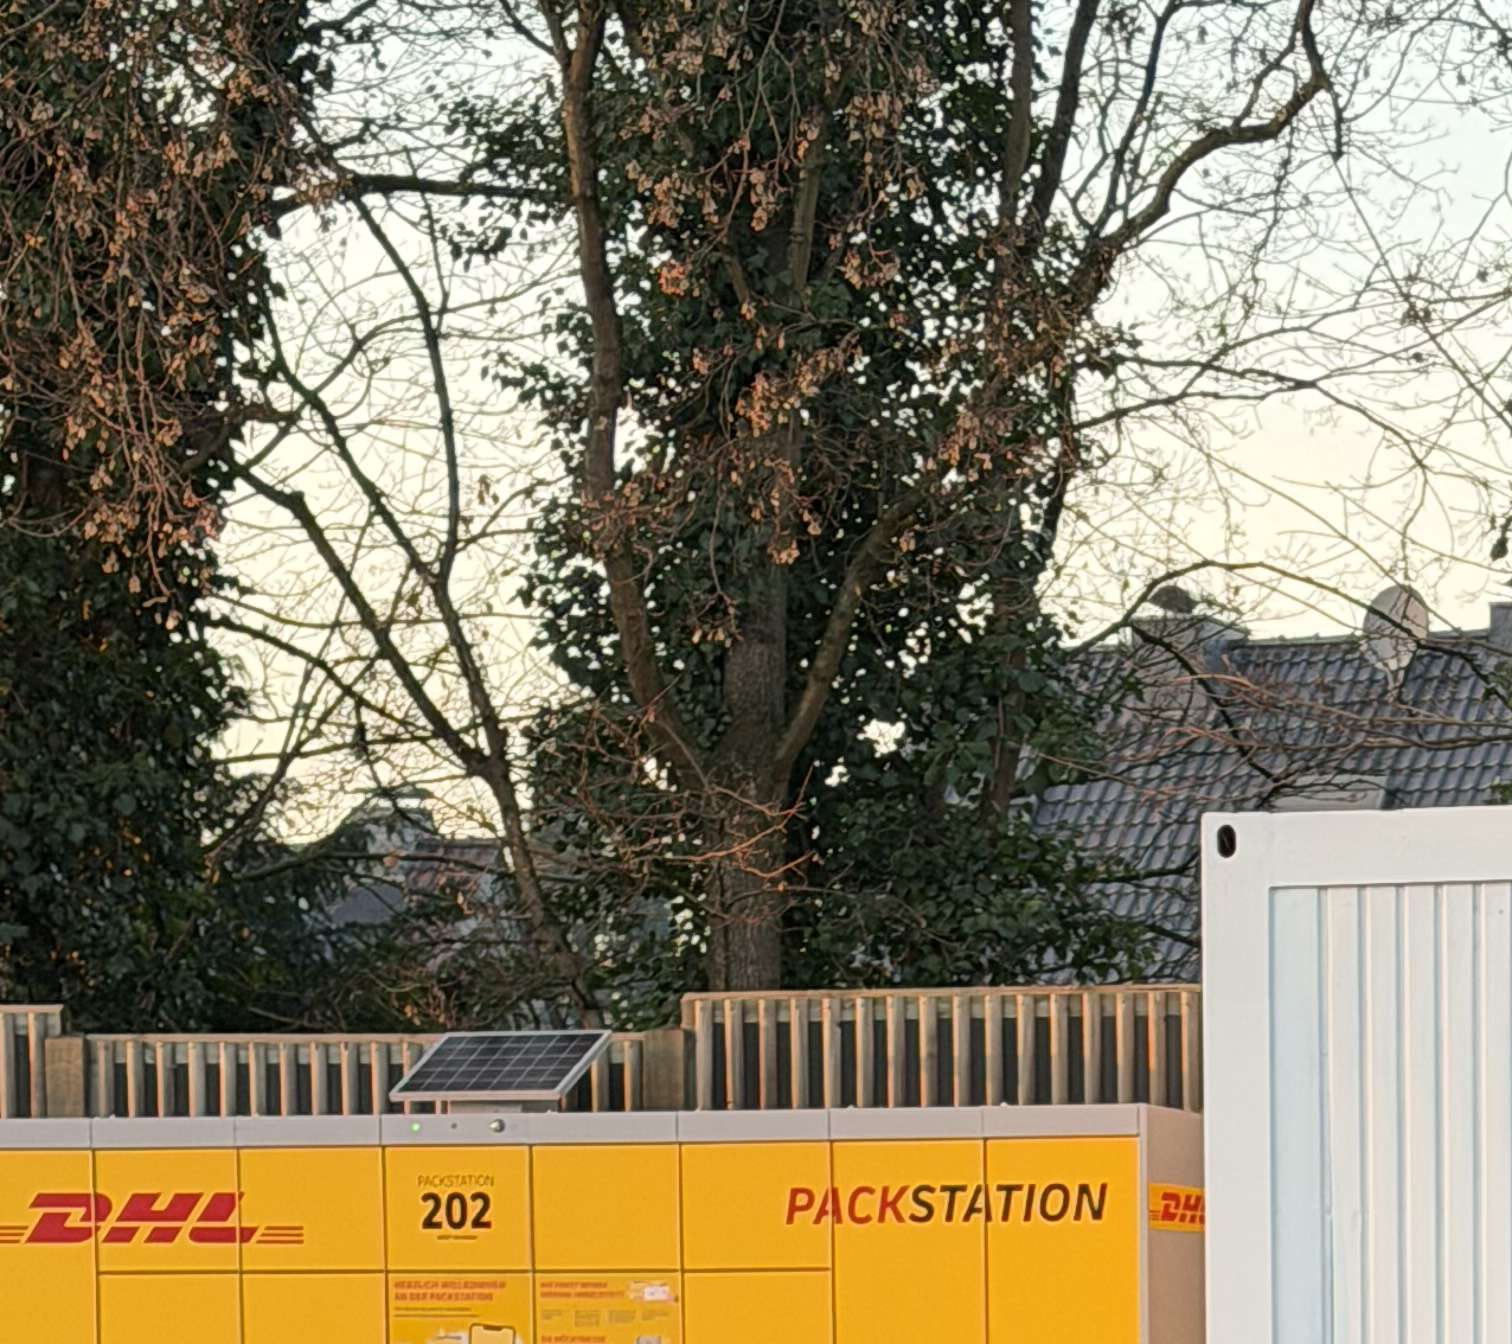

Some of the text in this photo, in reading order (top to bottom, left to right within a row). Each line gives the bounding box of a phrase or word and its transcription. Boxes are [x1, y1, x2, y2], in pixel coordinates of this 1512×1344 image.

[417, 1174, 495, 1187] PACKSTATION
[25, 1192, 259, 1244] DHL
[421, 1191, 492, 1230] 202
[785, 1182, 1107, 1226] PACKSTATION
